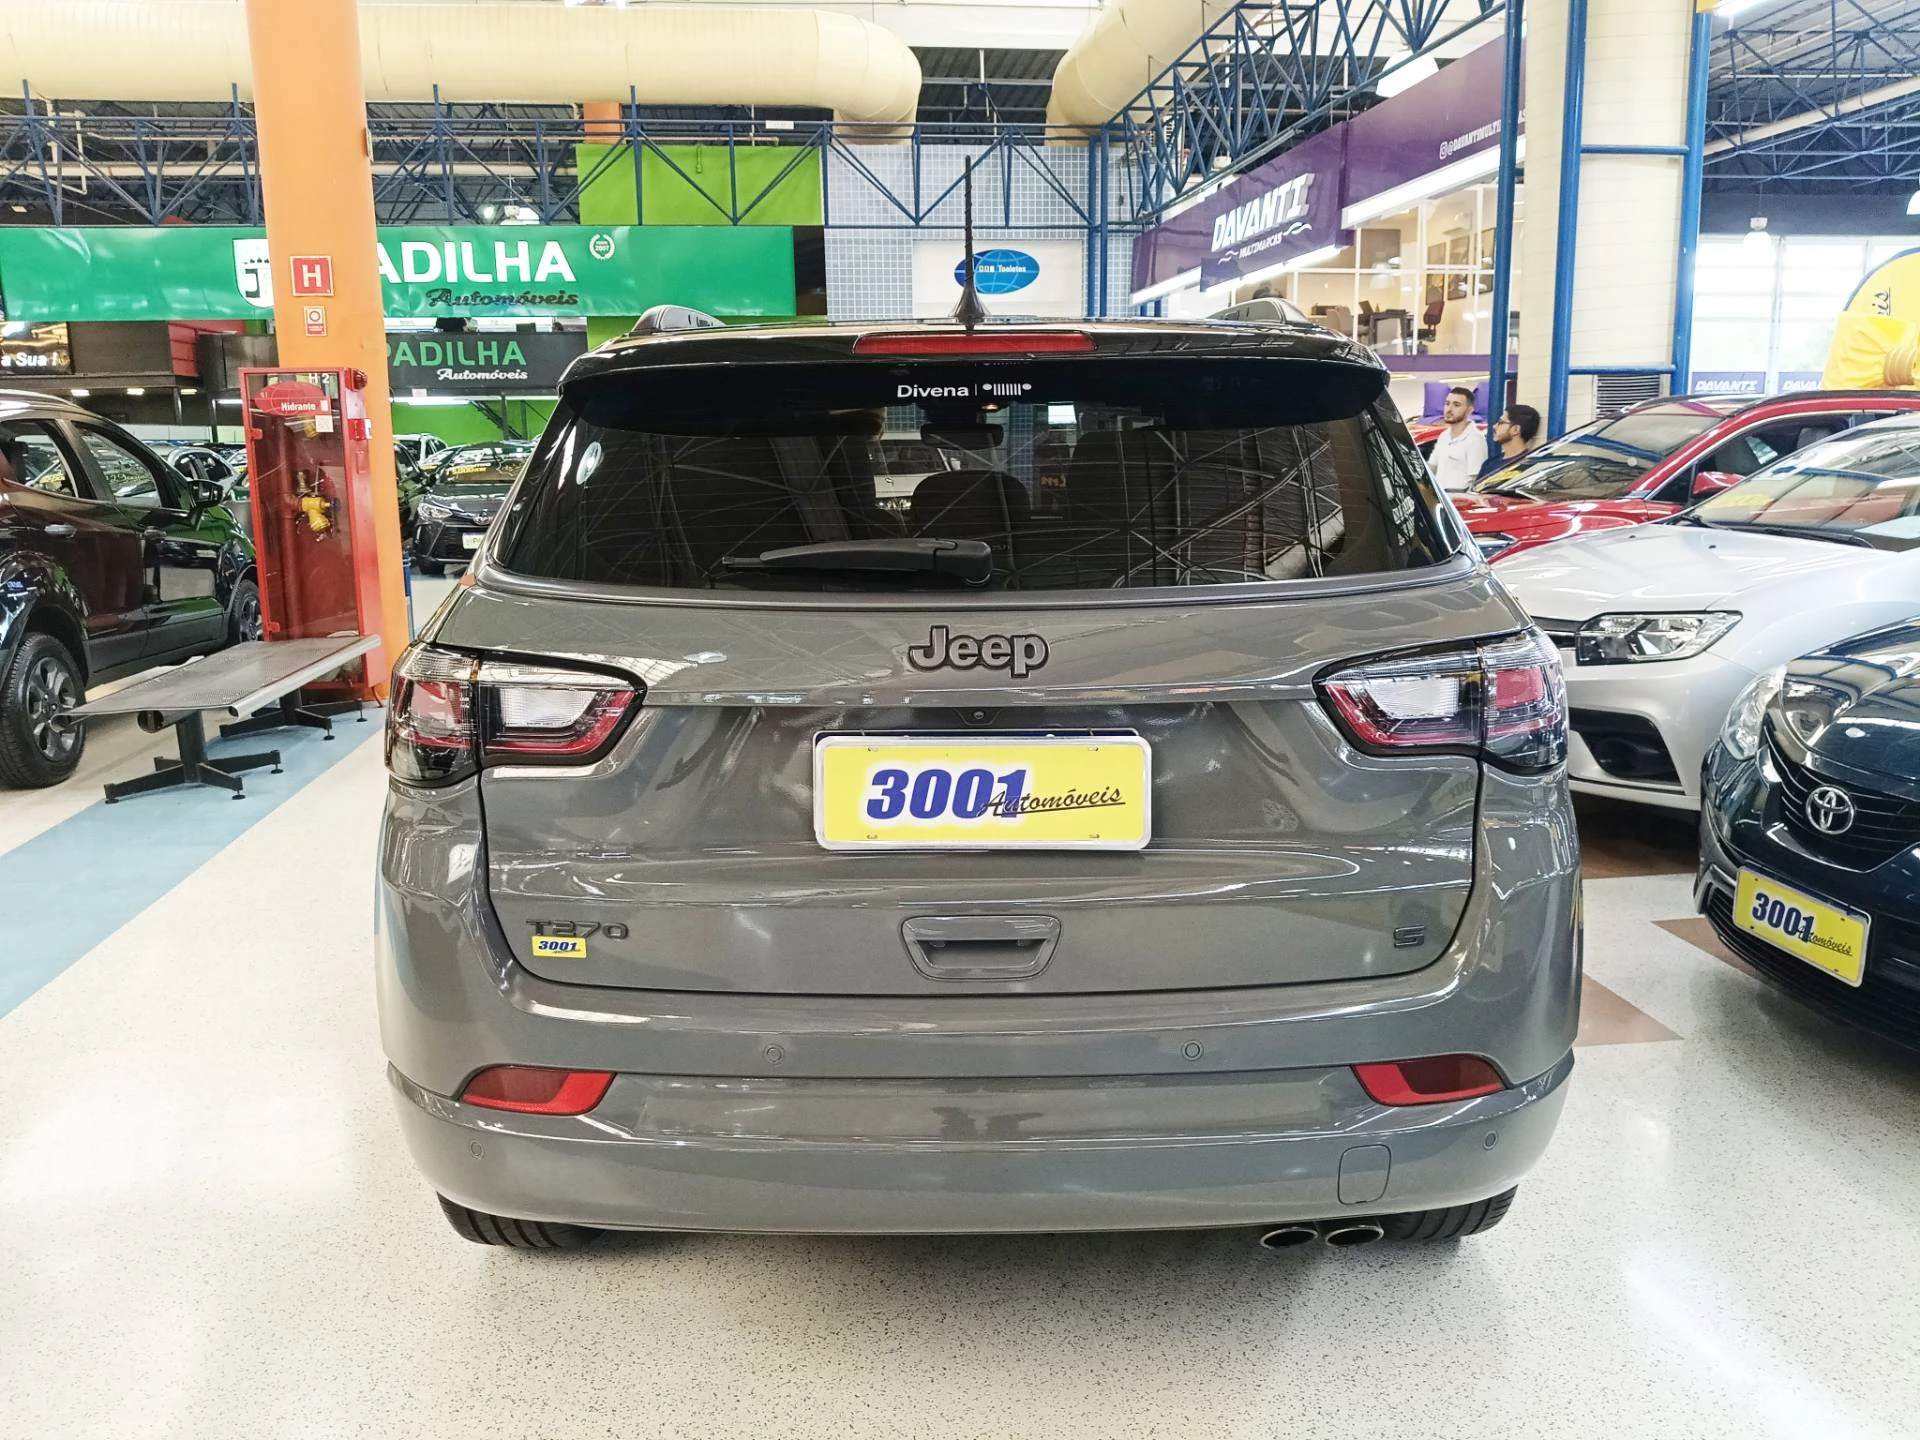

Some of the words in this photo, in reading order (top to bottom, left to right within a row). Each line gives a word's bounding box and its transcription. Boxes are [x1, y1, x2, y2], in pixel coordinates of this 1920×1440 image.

[1211, 173, 1315, 252] DAVANTI
[1239, 231, 1282, 258] MULTIMARCAS
[377, 241, 577, 284] ADILHA
[302, 264, 322, 287] H
[426, 288, 579, 307] Automóveis
[15, 352, 47, 367] Sua
[386, 341, 527, 366] ADILHA
[436, 368, 528, 381] Automóveis
[897, 384, 969, 398] Divena
[281, 402, 316, 411] Hidrante
[908, 624, 1050, 679] Jeep
[866, 768, 1028, 819] 3001
[978, 786, 1124, 817] Automóveis
[526, 919, 629, 940] T270
[1752, 892, 1815, 944] 3001
[538, 940, 578, 951] 3001
[1393, 924, 1424, 949] S
